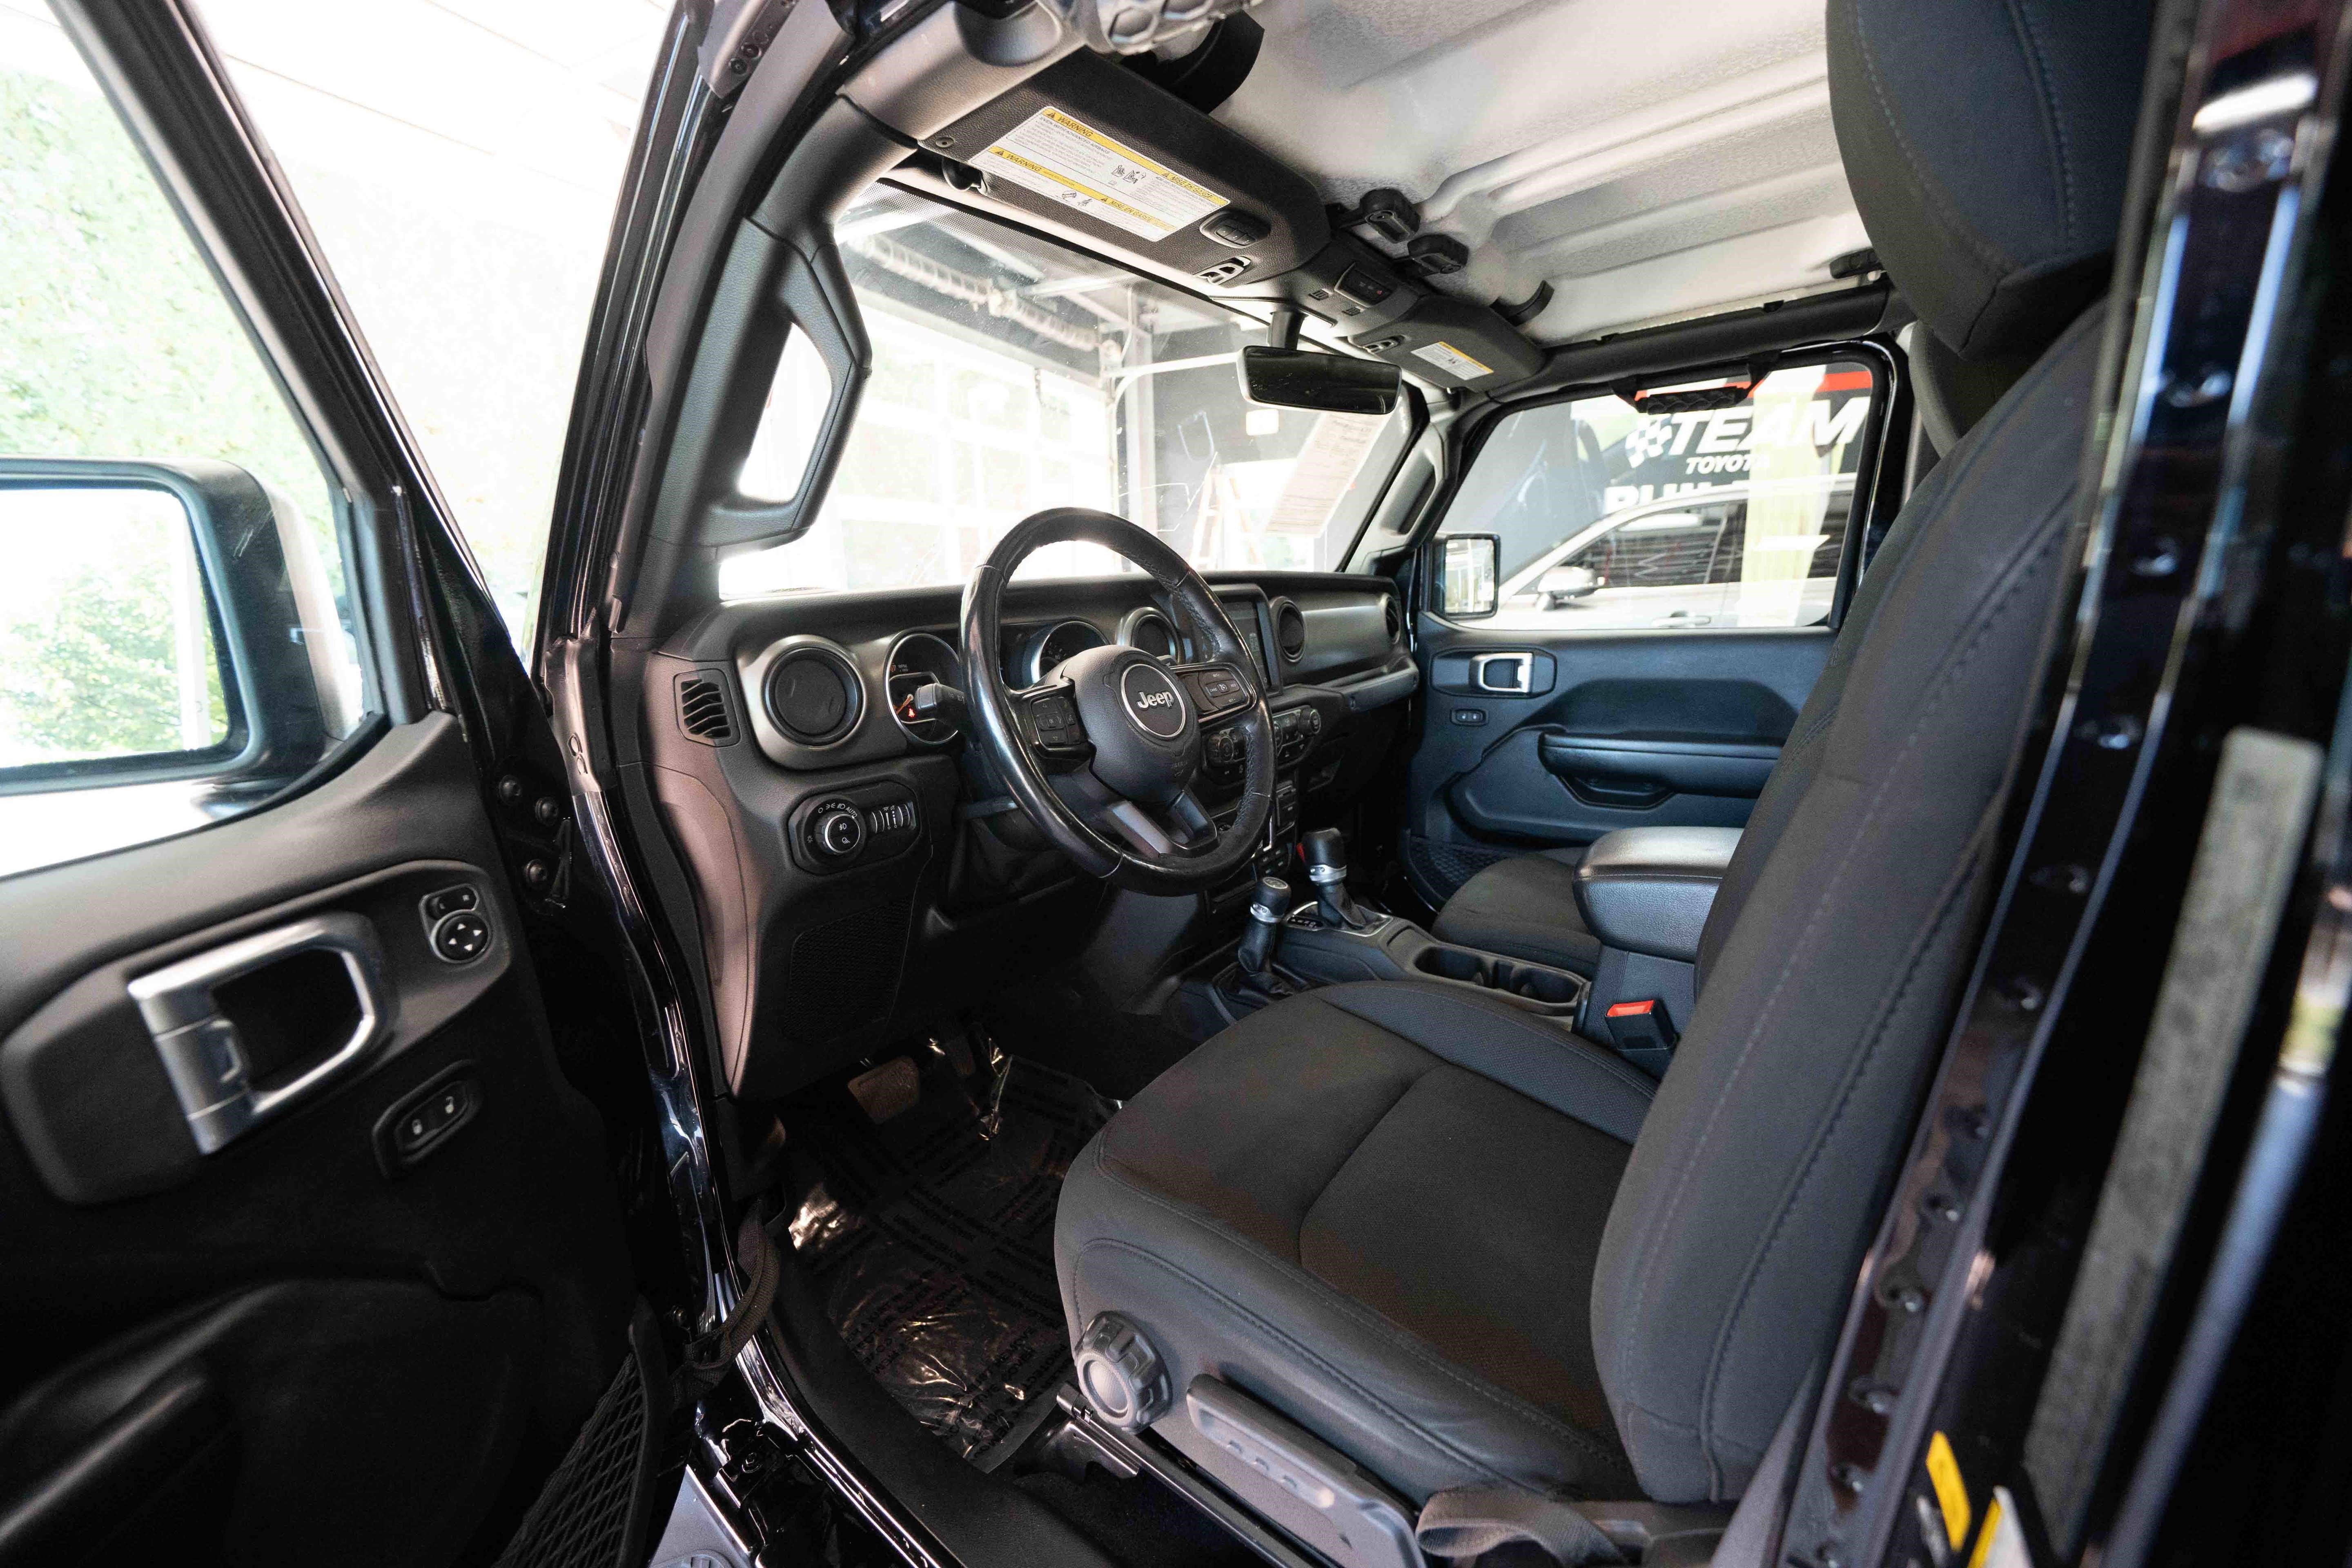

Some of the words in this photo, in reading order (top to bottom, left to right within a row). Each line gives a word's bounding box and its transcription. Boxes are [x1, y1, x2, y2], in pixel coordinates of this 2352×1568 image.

[1058, 116, 1093, 137] WARNING
[1006, 154, 1042, 172] WARNING
[1171, 176, 1186, 185] MISE
[1109, 200, 1124, 209] MISE
[1668, 396, 1870, 456] TEAM
[1137, 691, 1174, 709] Jeep
[845, 807, 858, 817] AUTO
